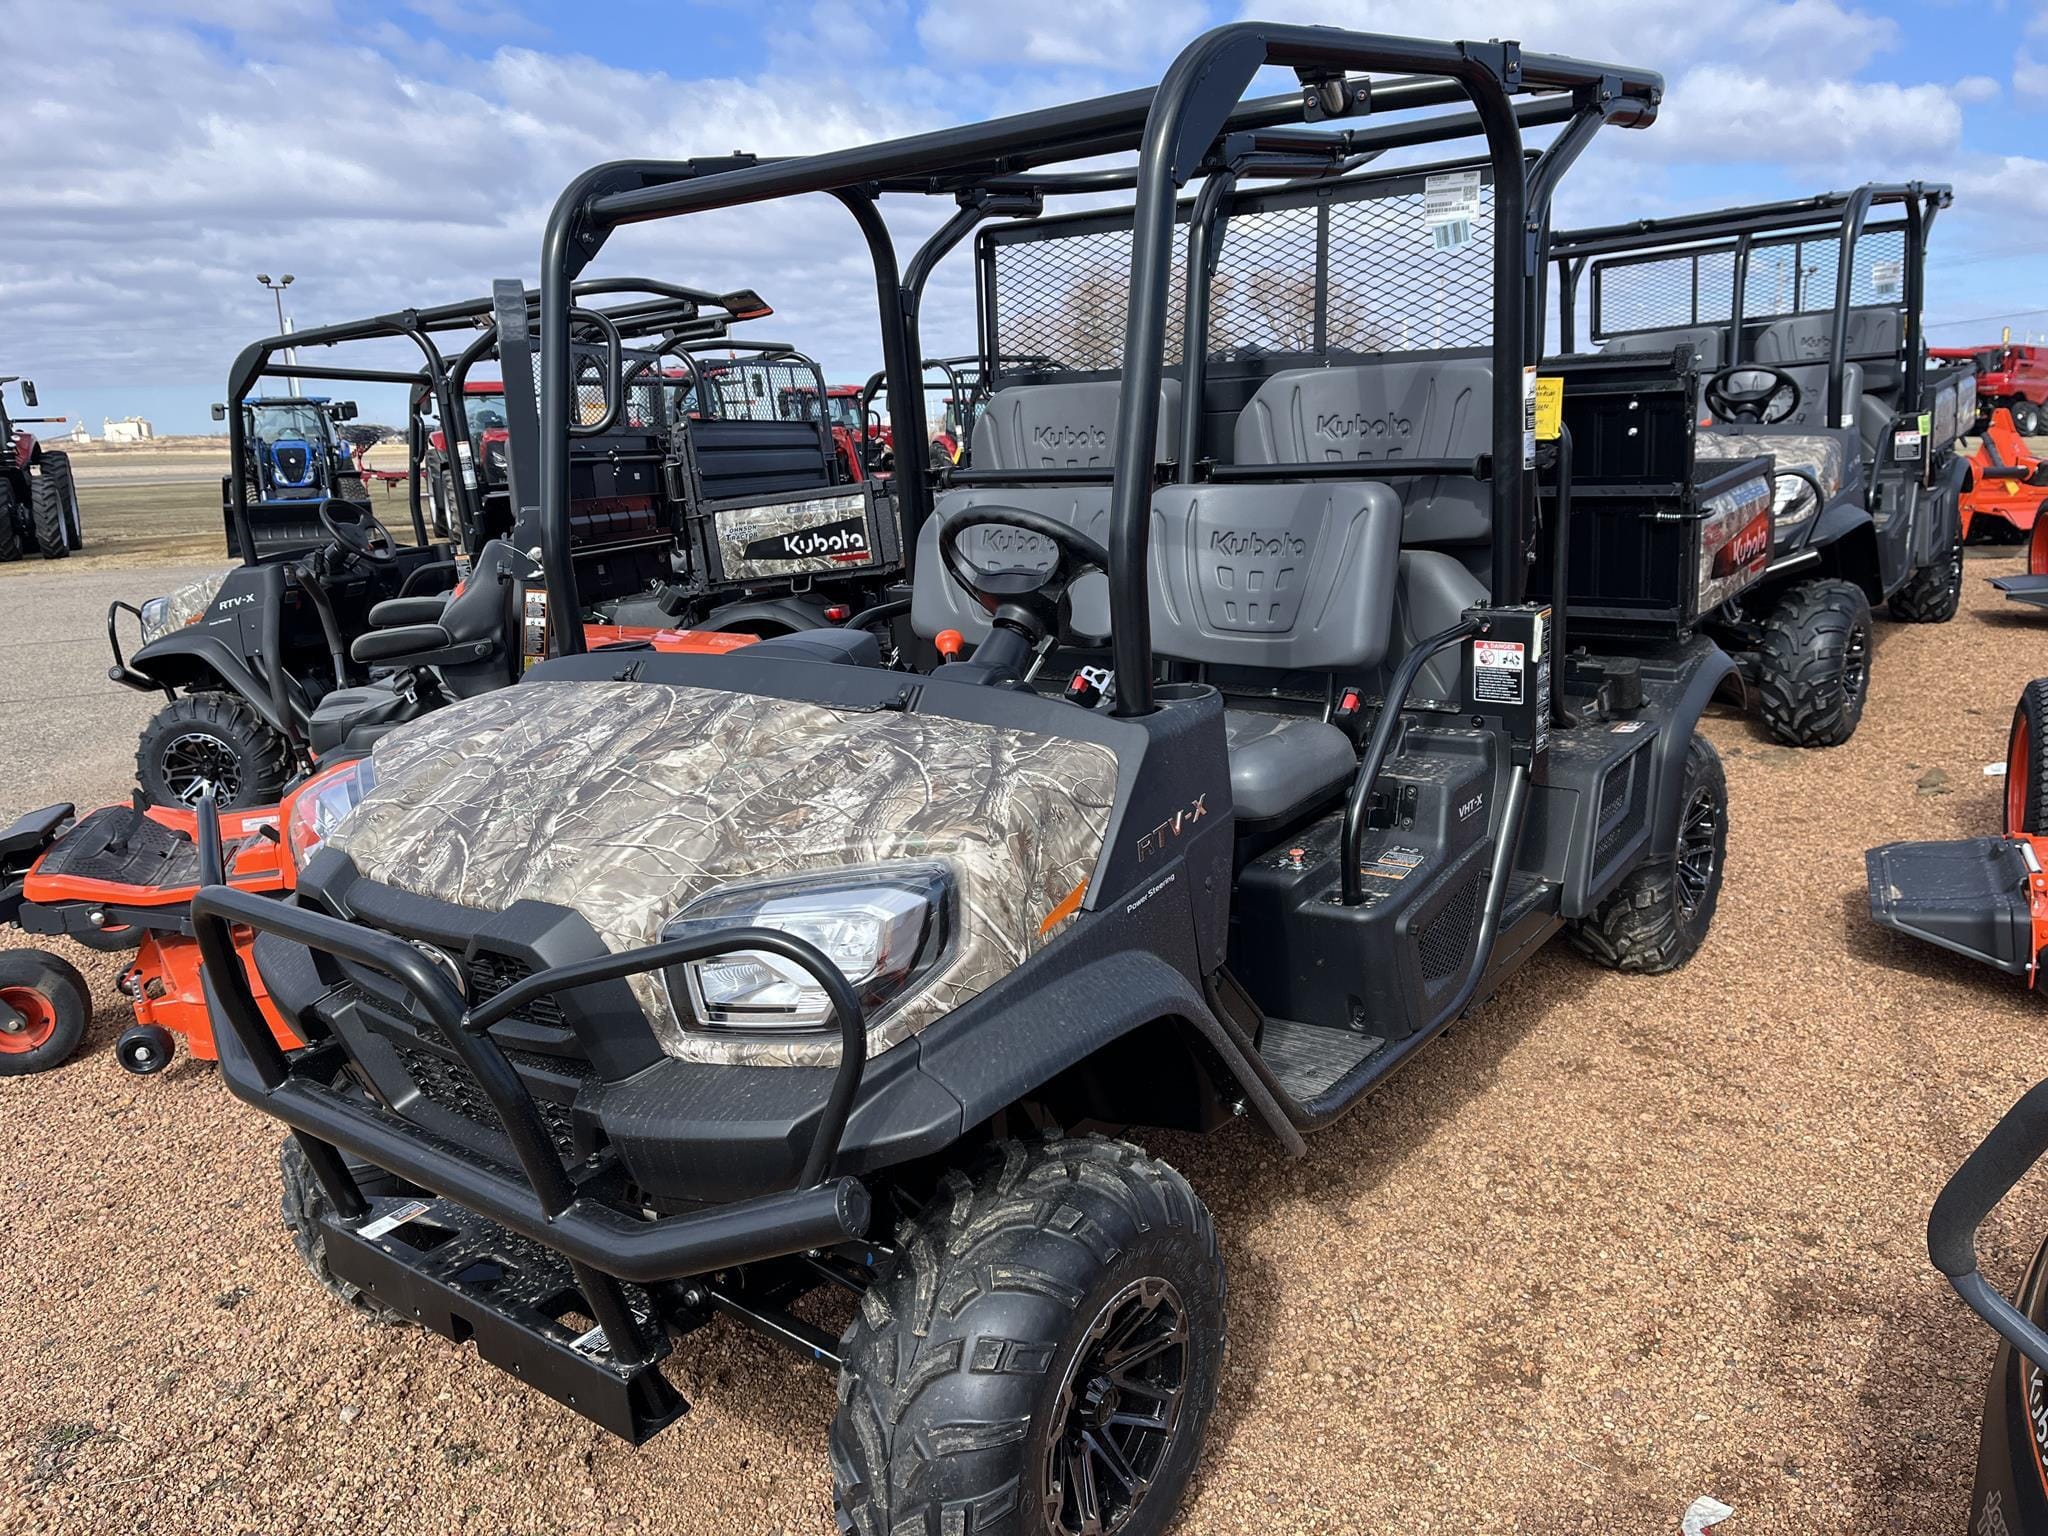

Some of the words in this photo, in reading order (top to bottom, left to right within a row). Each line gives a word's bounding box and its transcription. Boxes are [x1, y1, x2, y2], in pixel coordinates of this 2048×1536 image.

[1033, 425, 1106, 449] Kubota
[1316, 412, 1412, 440] Kubota
[783, 529, 864, 555] Kubota
[1209, 531, 1306, 558] Kubota
[1733, 525, 1767, 566] Kubota
[219, 593, 255, 611] RTV-X
[1459, 793, 1482, 818] VHT-X
[1137, 792, 1207, 863] RTV-X
[1126, 893, 1148, 914] Power
[1147, 873, 1175, 898] Steering
